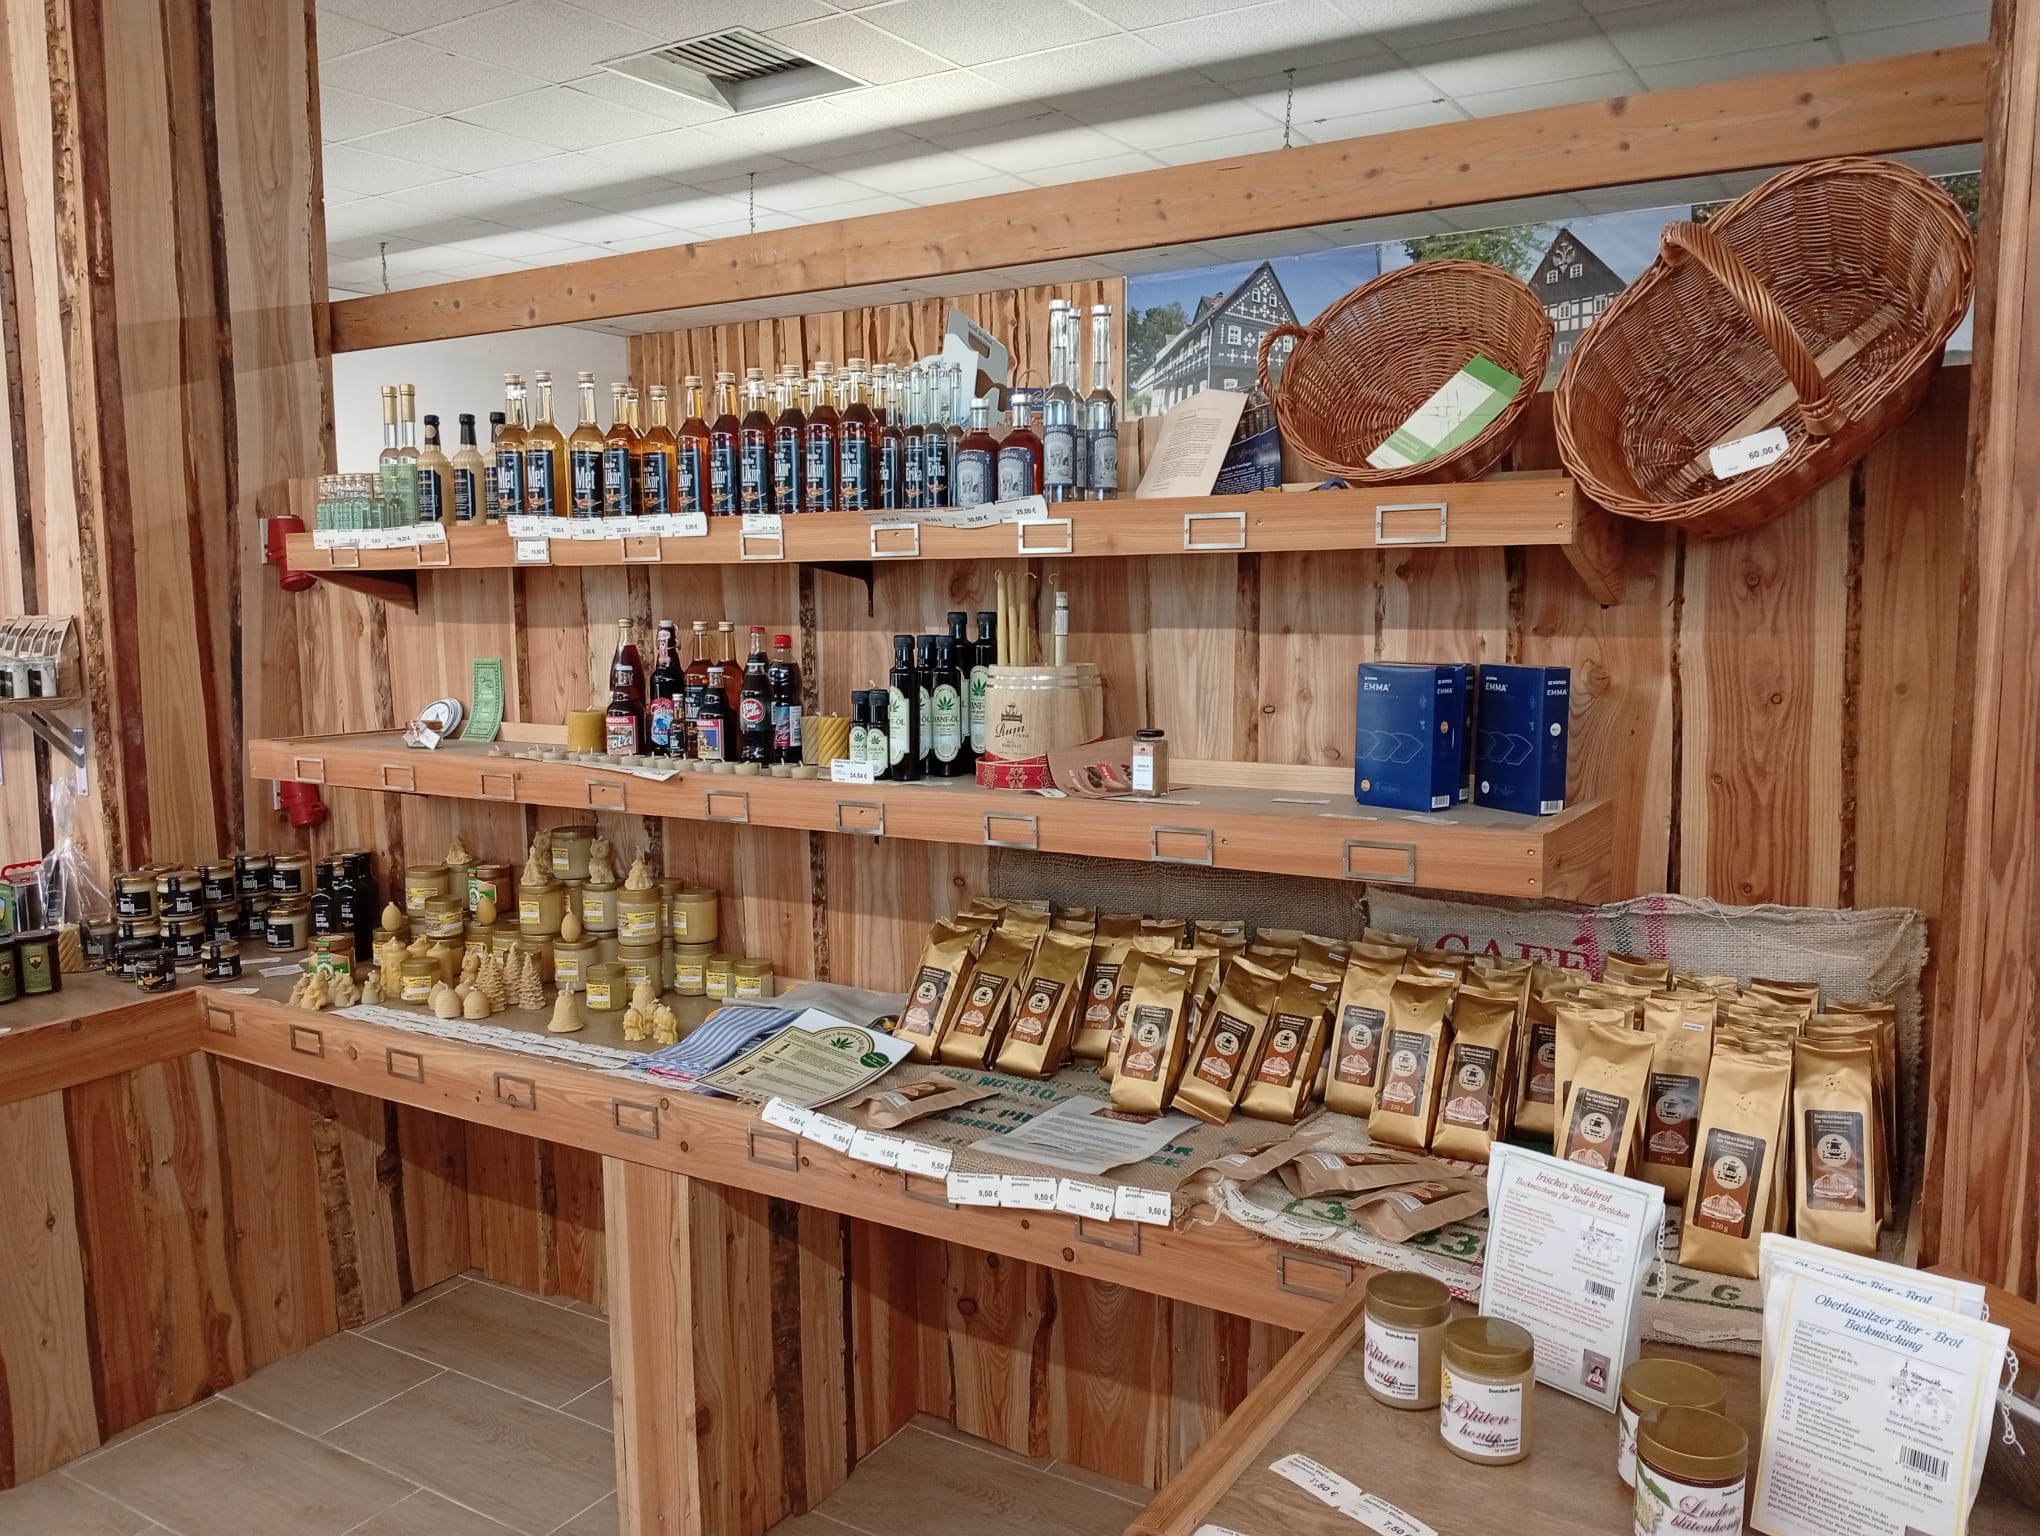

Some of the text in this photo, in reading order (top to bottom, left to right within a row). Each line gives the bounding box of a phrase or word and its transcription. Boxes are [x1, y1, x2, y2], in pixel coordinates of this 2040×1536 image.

[1775, 443, 1782, 451] €
[528, 466, 544, 488] Met
[928, 463, 945, 477] Erika
[575, 467, 595, 489] Met
[1364, 683, 1389, 692] EMMA
[1485, 683, 1506, 692] EMMA
[176, 901, 193, 912] Honig
[978, 1190, 993, 1198] 9,50
[1536, 1172, 1613, 1203] Irisches Sodabrot
[1034, 1193, 1049, 1201] 9,50
[1090, 1201, 1104, 1211] 9,50
[1148, 1206, 1162, 1216] 9,50
[1558, 1191, 1571, 1202] für
[1598, 1201, 1631, 1220] Brötchen
[1814, 1293, 1894, 1328] Oberlausitzer
[1895, 1316, 1923, 1336] Bier
[1934, 1330, 1966, 1350] Brot
[1844, 1318, 1925, 1352] Backmischung
[1448, 1395, 1517, 1425] Blüten-
[1459, 1422, 1501, 1448] honig
